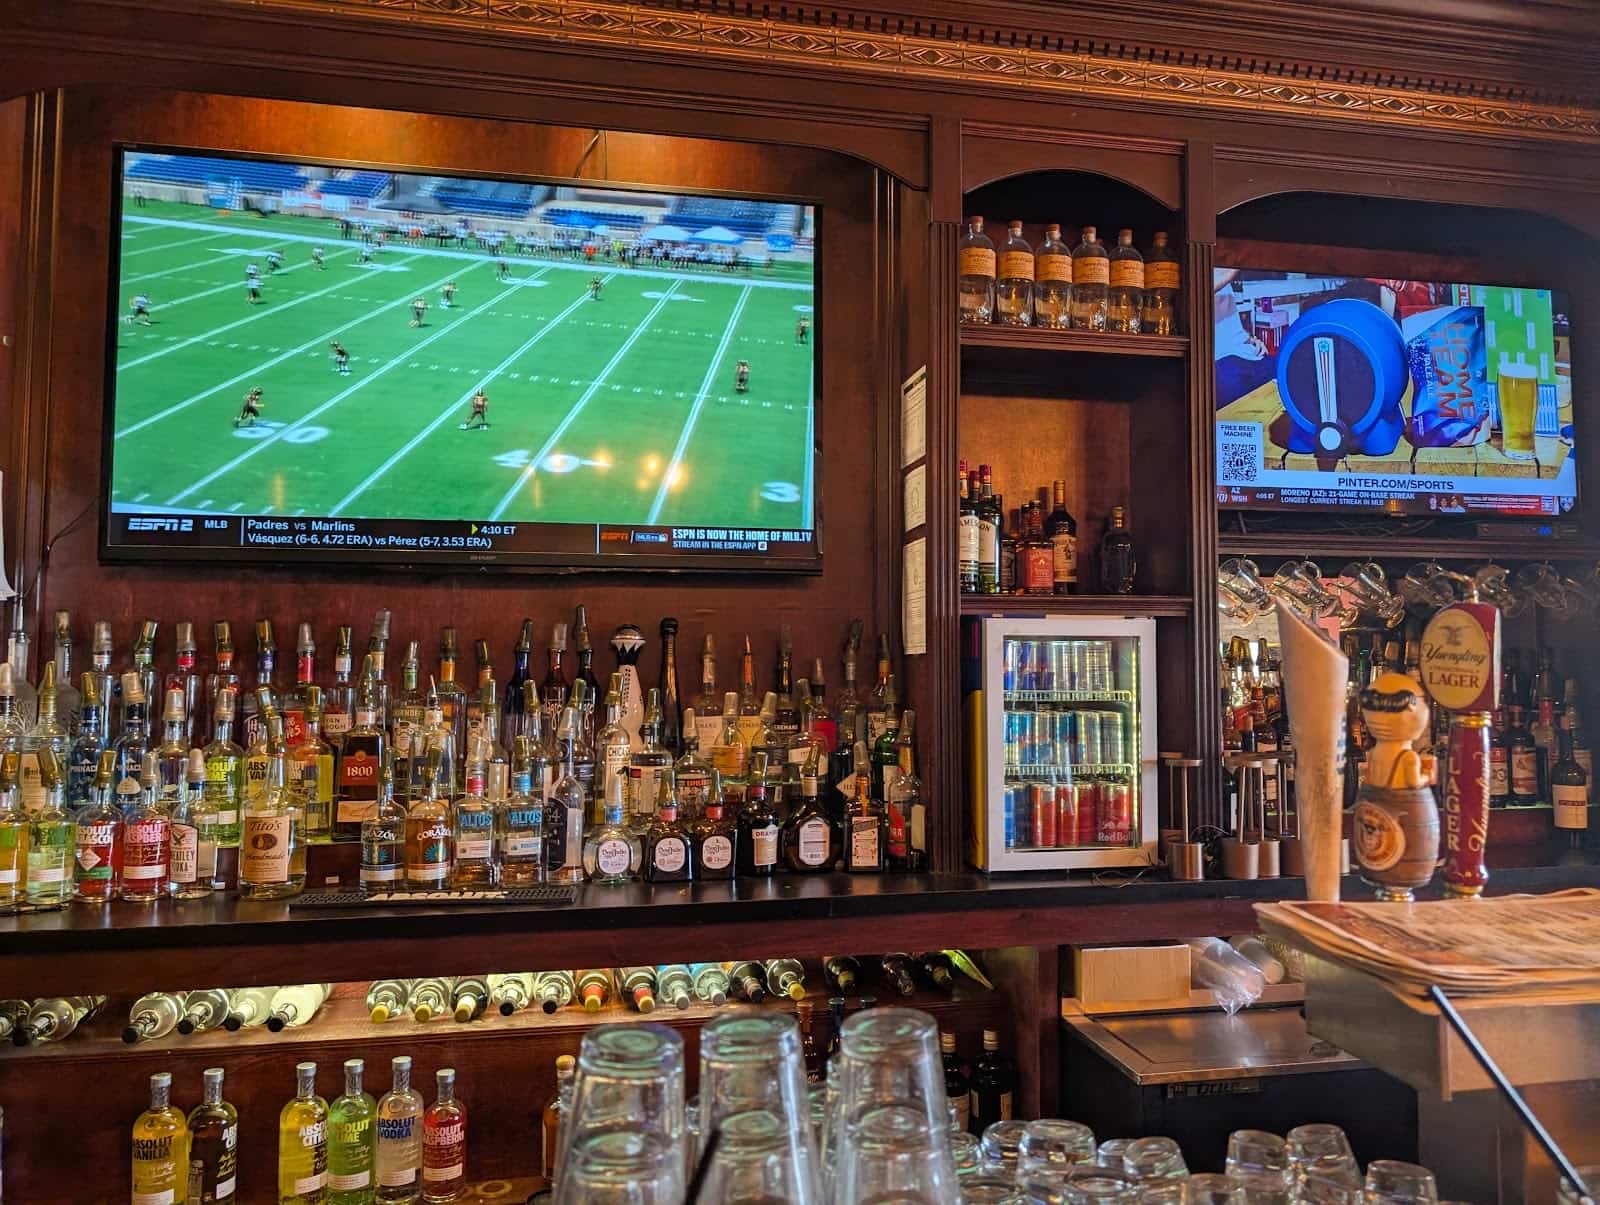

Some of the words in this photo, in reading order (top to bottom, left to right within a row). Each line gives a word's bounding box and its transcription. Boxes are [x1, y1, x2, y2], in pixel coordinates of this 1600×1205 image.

[1338, 478, 1454, 490] PINTER.COM/SPORTS
[204, 519, 228, 529] MLB
[247, 519, 289, 530] Padres
[294, 522, 306, 530] vs
[311, 520, 356, 531] Marlins
[480, 525, 501, 534] 4:10
[503, 526, 516, 535] ET
[672, 528, 695, 539] ESPN
[696, 529, 705, 539] IS
[707, 529, 727, 540] NOW
[728, 530, 744, 540] THE
[745, 530, 769, 541] HOME
[770, 531, 782, 541] OF
[247, 533, 293, 545] Vásquez
[295, 534, 321, 546] (6-6,
[322, 535, 345, 545] 4.72
[346, 535, 373, 546] ERA)
[374, 537, 386, 545] vs
[388, 535, 417, 546] Pérez
[442, 537, 464, 547] 3.53
[466, 537, 492, 549] ERA)
[672, 540, 701, 549] STREAM
[702, 541, 710, 549] IN
[711, 541, 723, 549] THE
[724, 541, 742, 549] ESPN
[743, 542, 757, 550] APP
[1423, 642, 1487, 665] Yuengling
[1429, 671, 1479, 688] LAGER
[347, 766, 373, 777] 1800
[510, 810, 542, 825] ALTOS
[249, 820, 282, 831] Tito's
